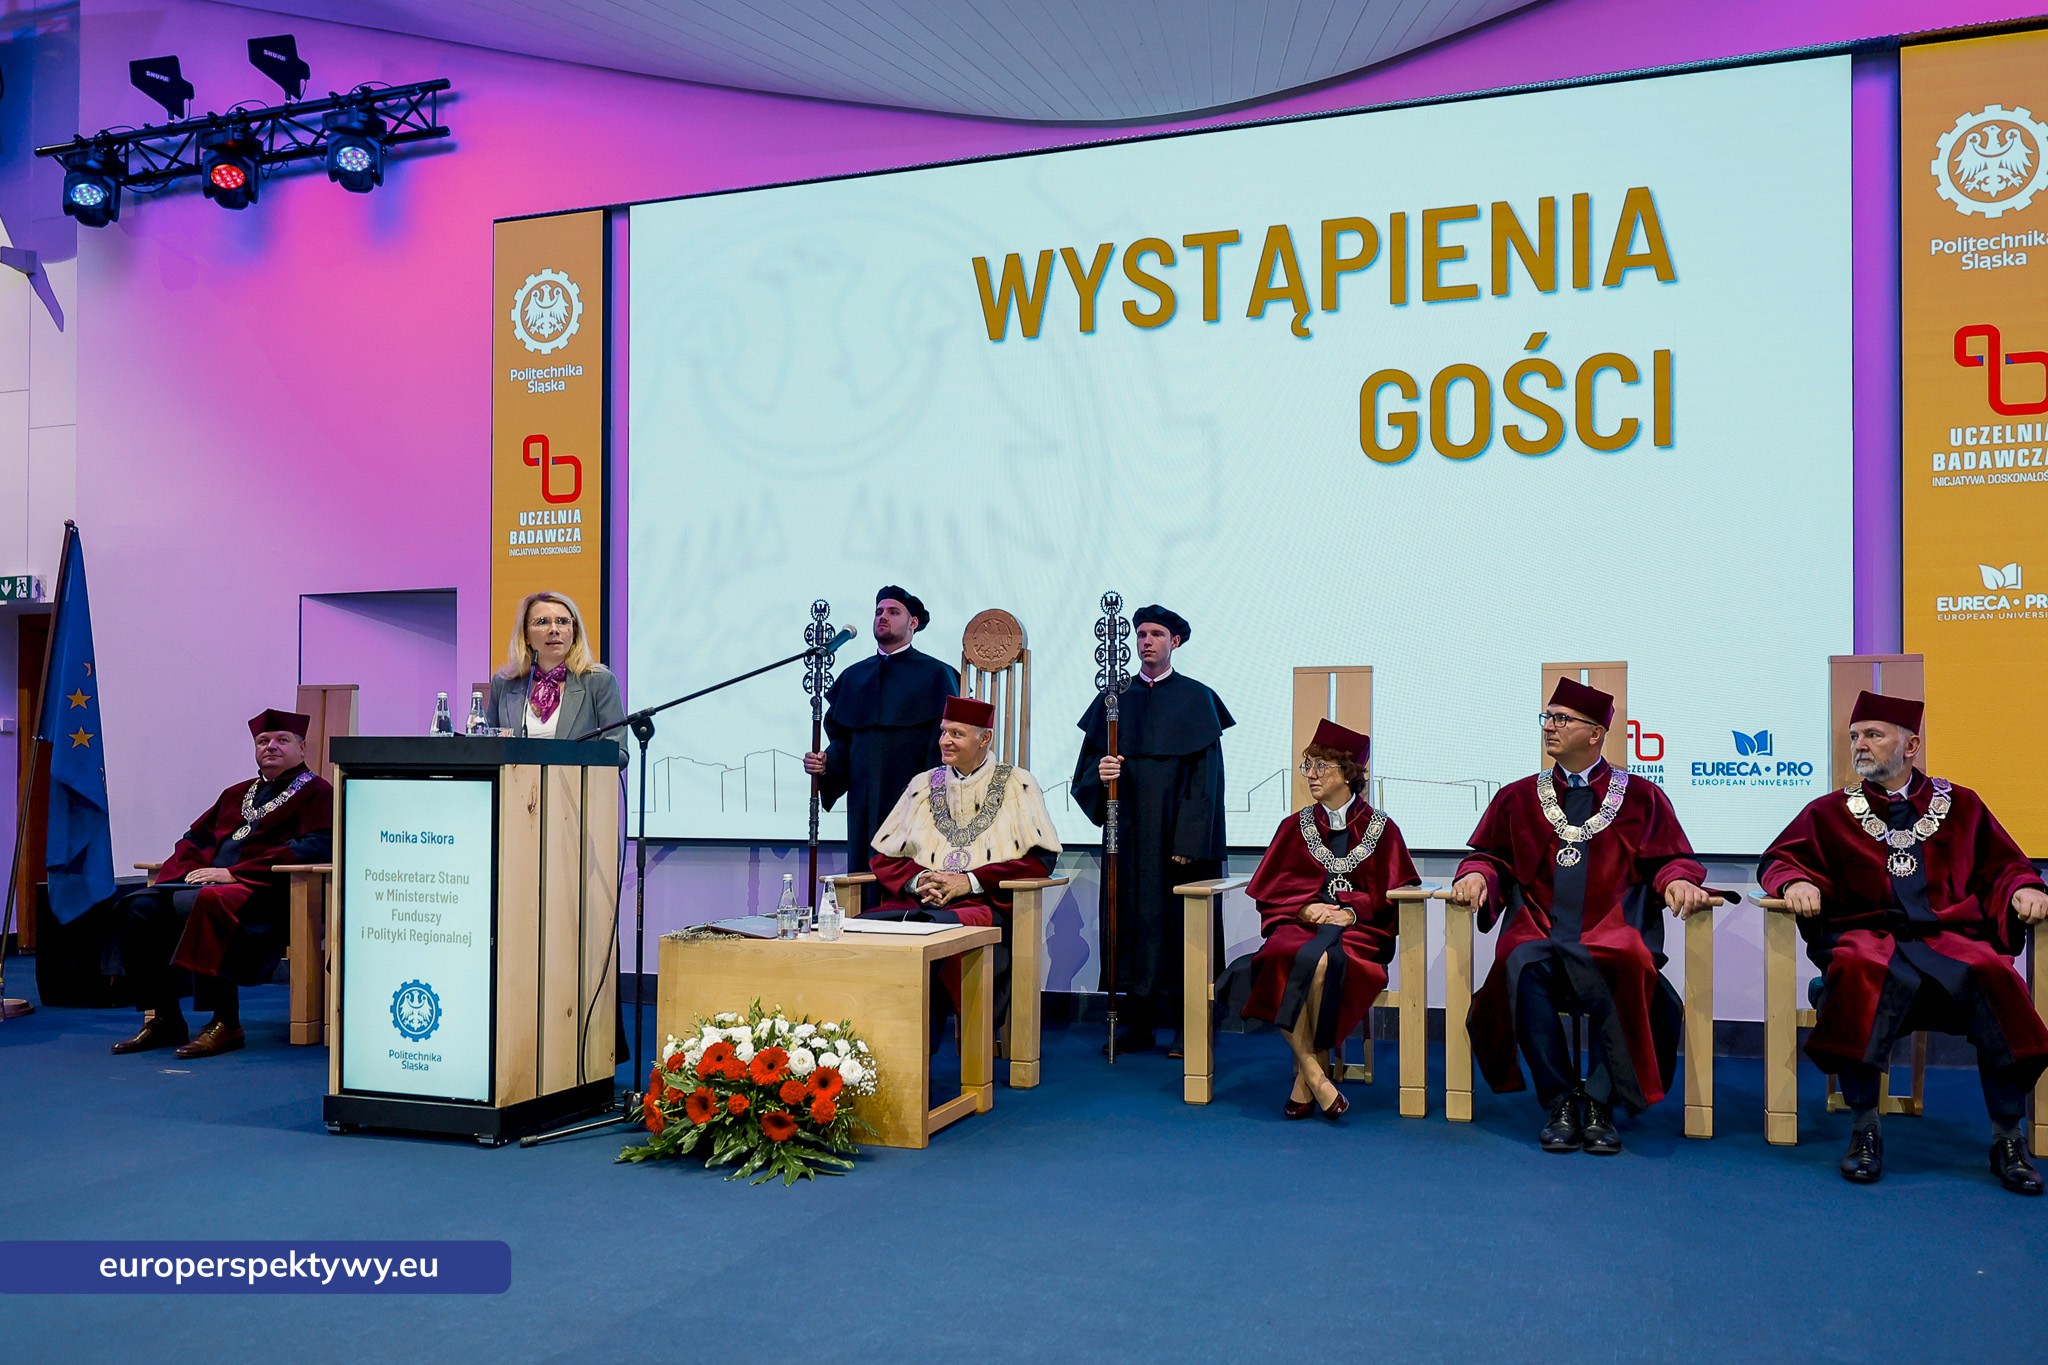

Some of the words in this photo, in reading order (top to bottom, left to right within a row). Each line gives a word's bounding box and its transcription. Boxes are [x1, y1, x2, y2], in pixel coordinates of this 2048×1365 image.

[1931, 229, 2048, 255] Politechnik
[972, 186, 1677, 341] WYSTĄPIENIA
[1961, 250, 2028, 270] Śląska
[510, 363, 583, 381] Politechnika
[527, 379, 566, 394] Śląska
[1359, 331, 1674, 465] GOŚCI
[1932, 447, 2048, 472] BADAWCZ
[1932, 474, 1986, 487] INICJATYWA
[519, 508, 582, 527] UCZELNIA
[509, 527, 582, 545] BADAWCZA
[508, 547, 540, 557] INICJATYWA
[1936, 594, 2012, 612] EURECA
[2024, 593, 2048, 609] PR
[1937, 612, 1995, 621] EUROPEAN
[1627, 764, 1664, 774] CZELNIA
[1691, 761, 1763, 777] EURECA
[1776, 761, 1814, 777] PRO
[1691, 778, 1747, 787] EUROPEAN
[1750, 778, 1812, 787] UNIVERSITY
[380, 830, 418, 844] Monika
[420, 831, 455, 845] Sikora
[364, 868, 436, 884] Podsekretarz
[438, 871, 470, 885] Stanu
[375, 891, 384, 901] w
[386, 889, 459, 904] Ministerstwie
[391, 908, 442, 926] Funduszy
[361, 926, 365, 939] i
[367, 927, 407, 944] Polityki
[409, 929, 472, 948] Regionalnej
[388, 1049, 442, 1062] Politechnika
[401, 1060, 429, 1072] Śląska
